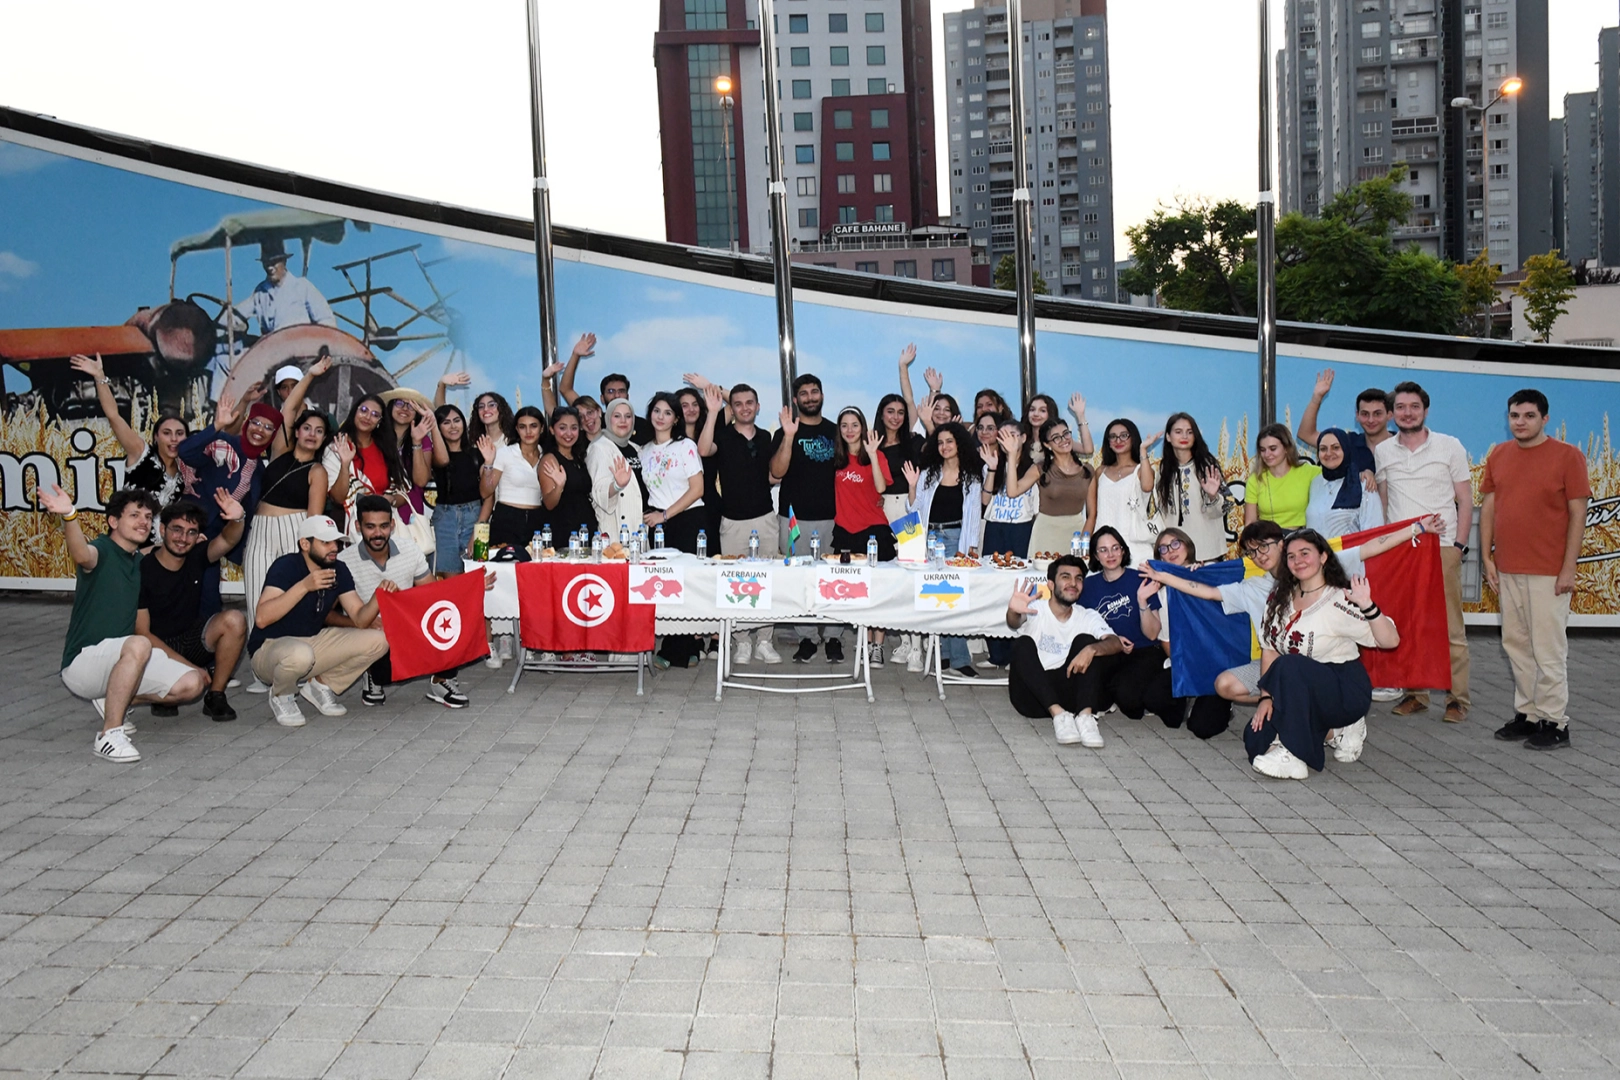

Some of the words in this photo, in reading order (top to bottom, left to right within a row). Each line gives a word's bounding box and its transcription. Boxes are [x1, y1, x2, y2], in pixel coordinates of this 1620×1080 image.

[834, 226, 860, 234] CAFE
[861, 224, 900, 233] BAHANE
[644, 566, 674, 574] TUNISIA
[721, 570, 767, 579] AZERBAIJAN
[923, 573, 961, 581] UKRAYNA
